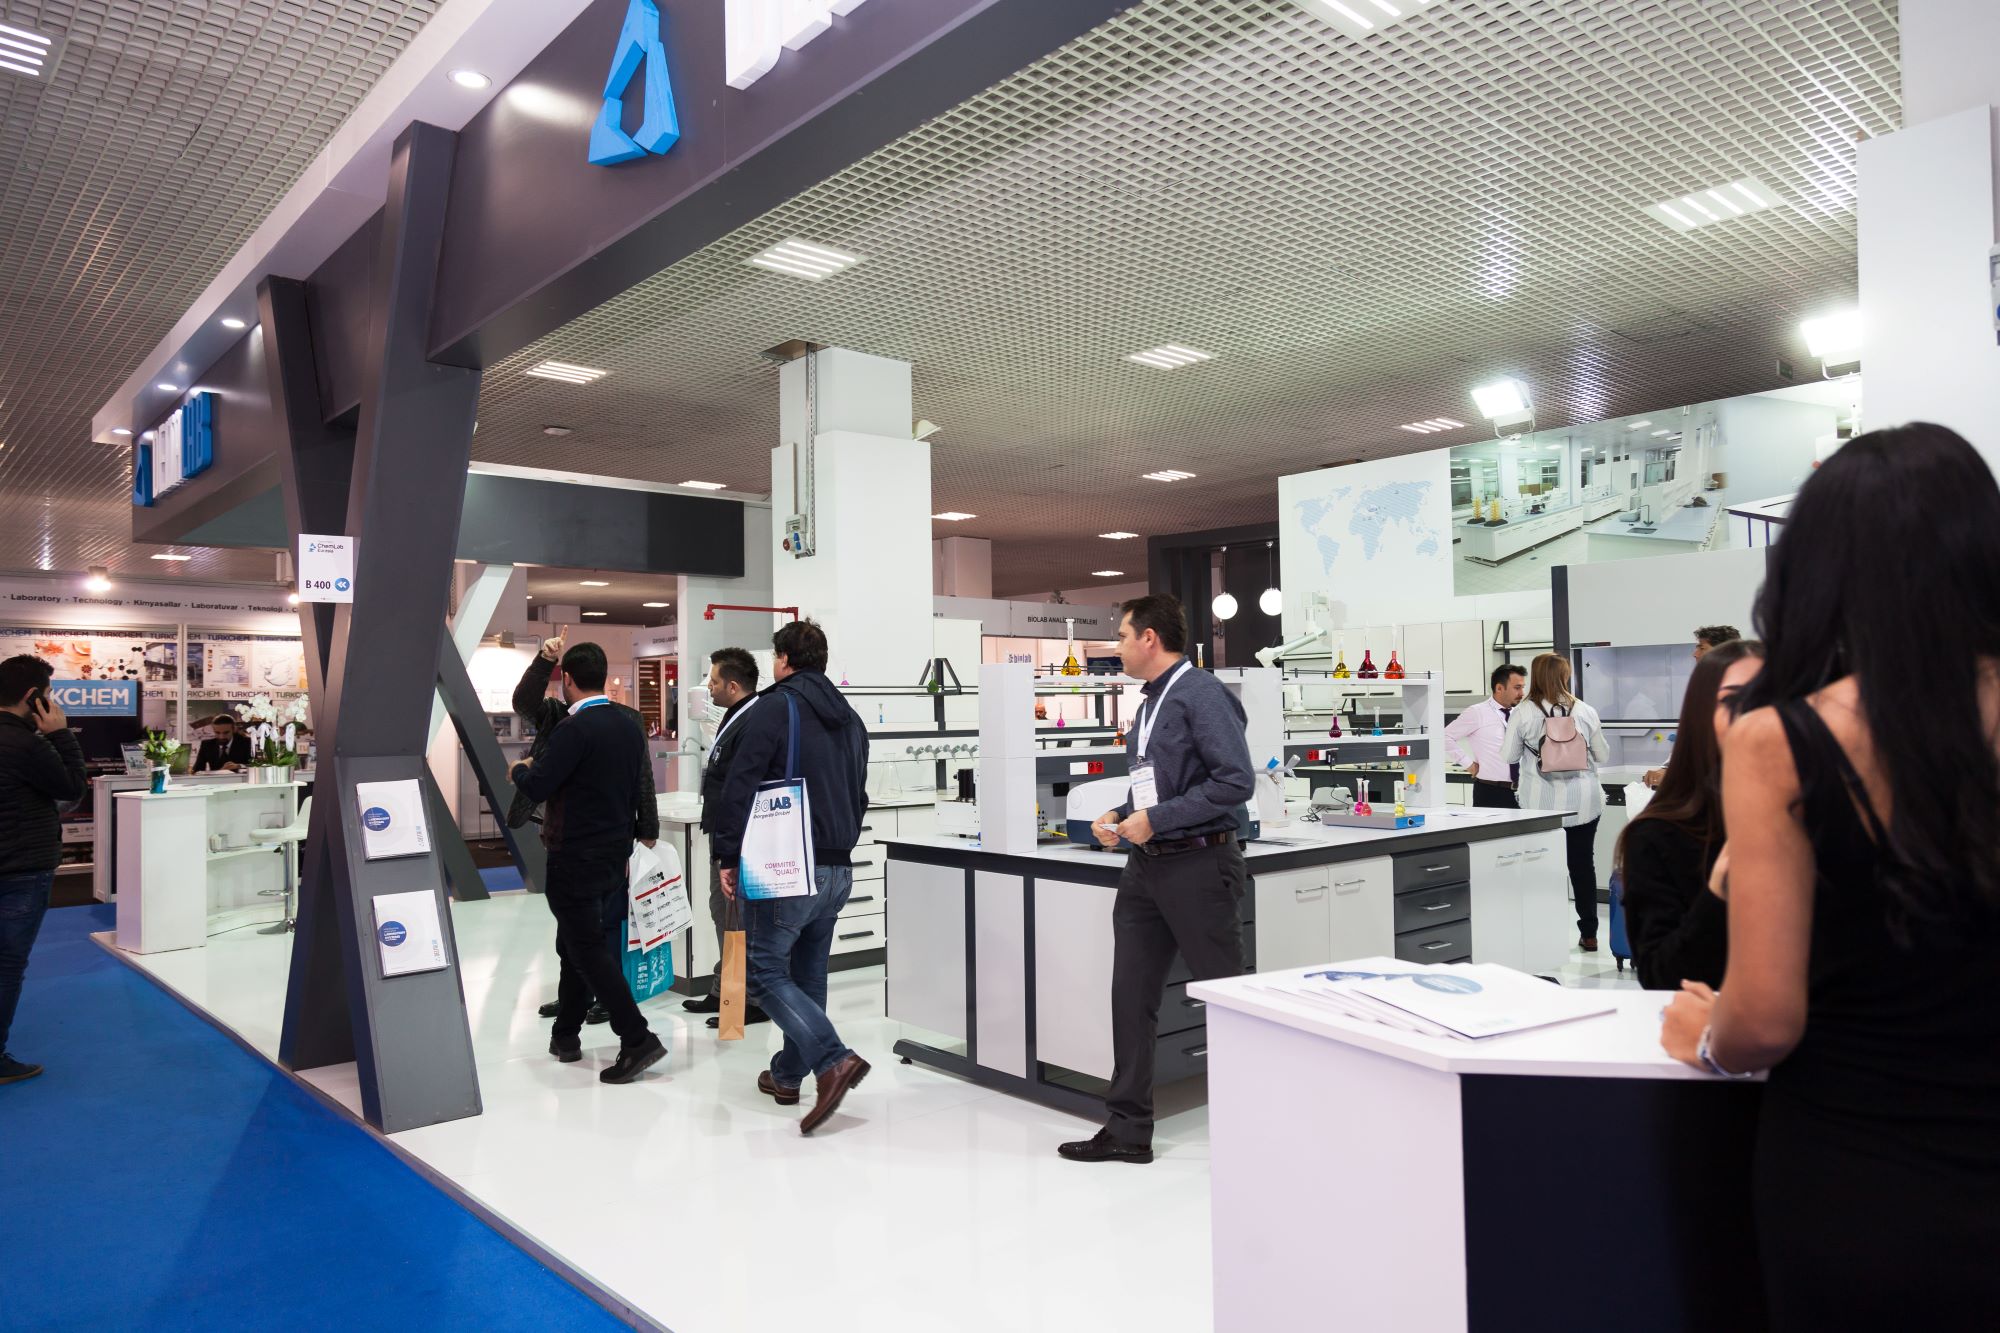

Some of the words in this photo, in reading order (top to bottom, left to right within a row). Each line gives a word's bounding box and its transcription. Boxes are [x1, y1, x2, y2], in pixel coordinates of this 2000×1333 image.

[305, 580, 312, 589] B
[314, 581, 331, 590] 400
[10, 594, 62, 603] Laboratory
[73, 596, 123, 605] Technology
[134, 599, 182, 607] Kimyasallar
[191, 602, 238, 610] Laboratuvar
[248, 605, 283, 613] Teknoloji
[775, 868, 800, 876] QUALITY
